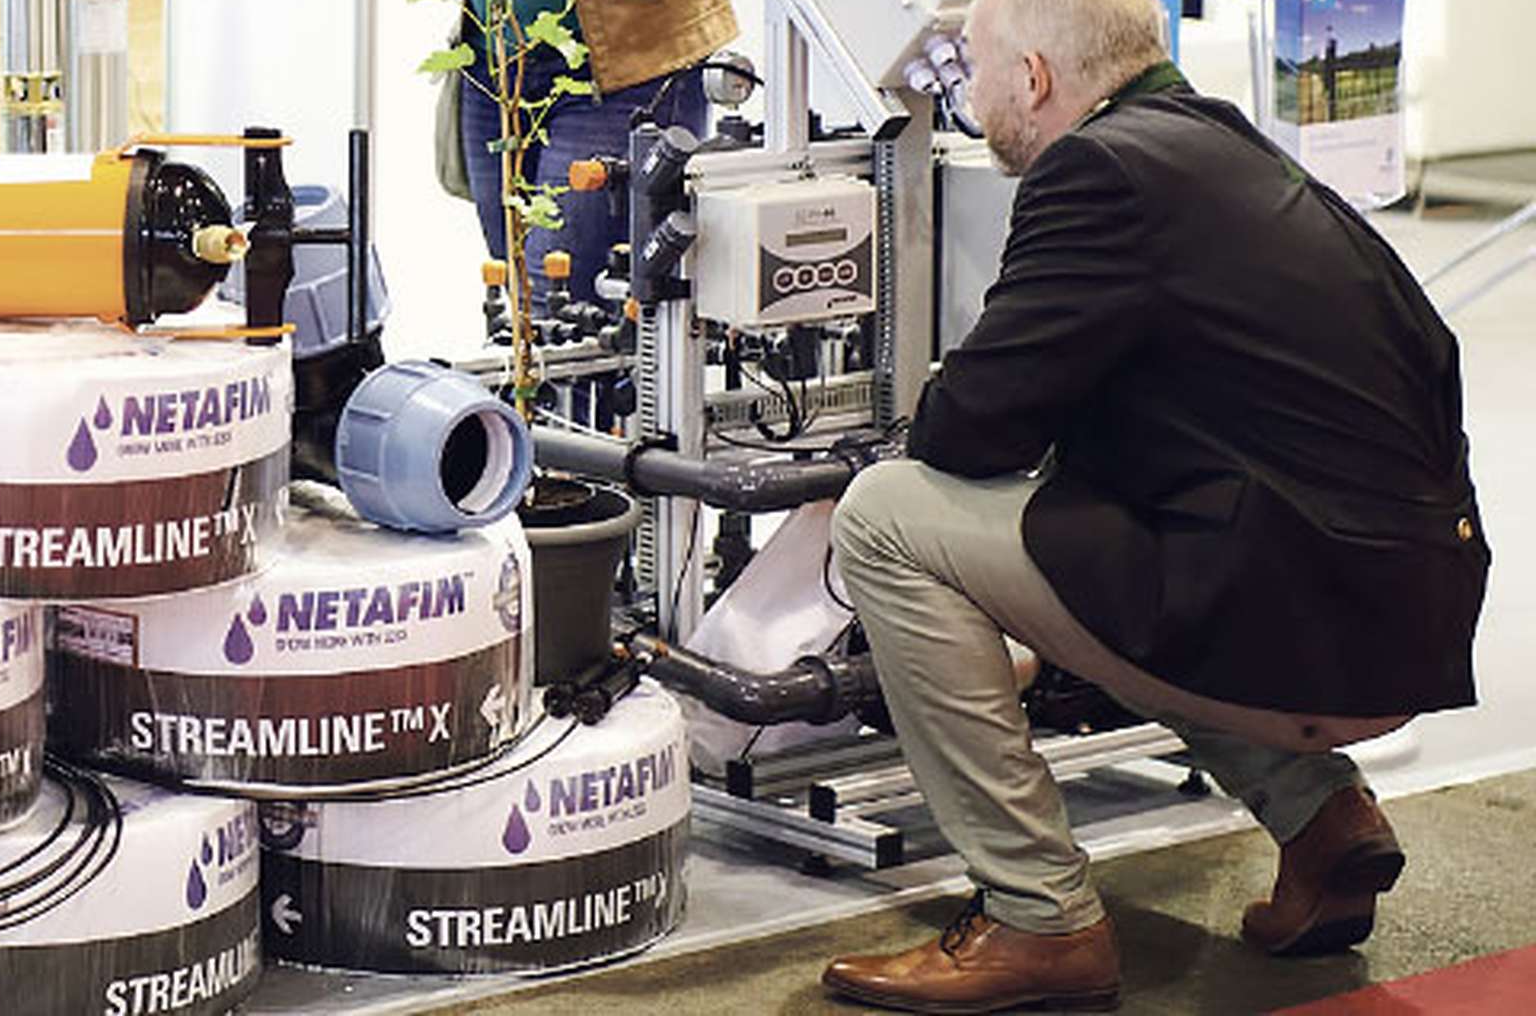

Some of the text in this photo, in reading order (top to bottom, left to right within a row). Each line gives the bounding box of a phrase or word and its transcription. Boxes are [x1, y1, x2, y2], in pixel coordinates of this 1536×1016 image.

[121, 375, 271, 436] NETAFIM
[275, 574, 465, 633] NETAFIM
[428, 701, 452, 744] X
[549, 743, 676, 818] NETAFIM
